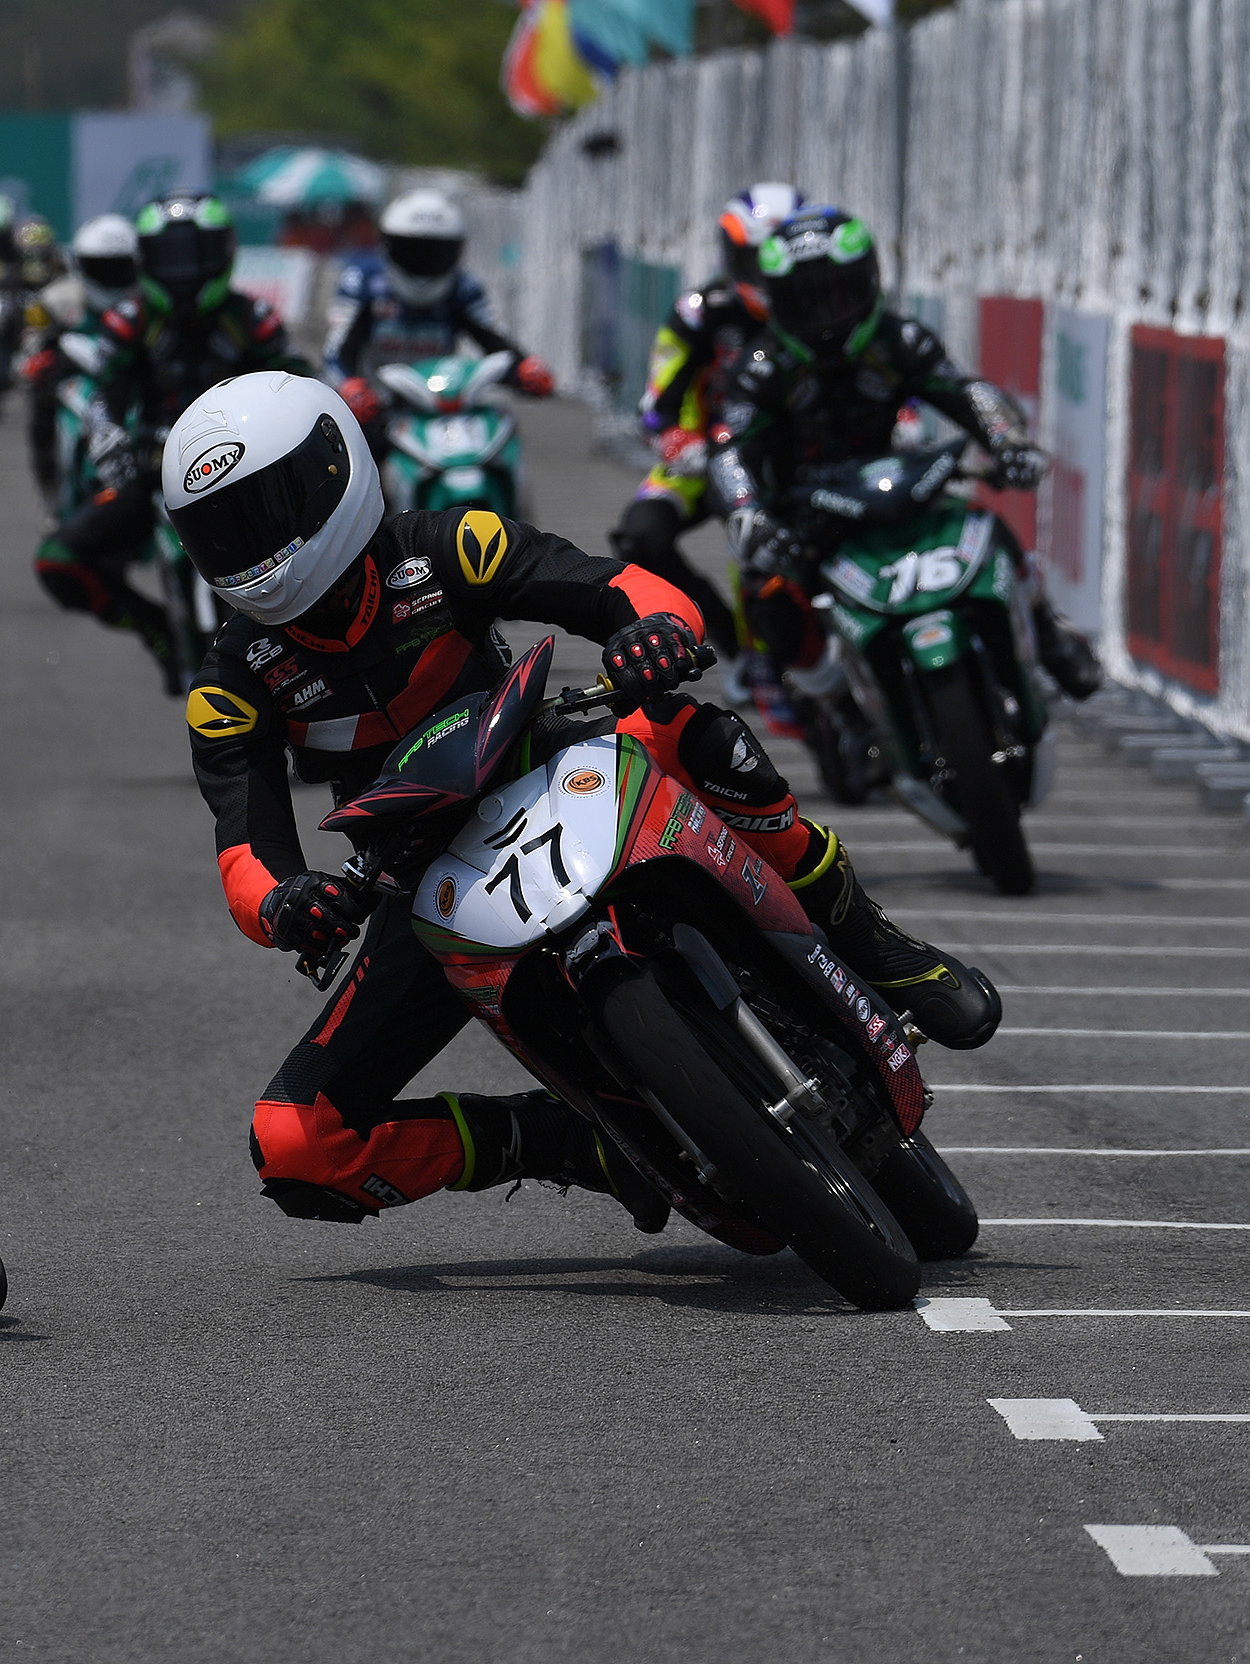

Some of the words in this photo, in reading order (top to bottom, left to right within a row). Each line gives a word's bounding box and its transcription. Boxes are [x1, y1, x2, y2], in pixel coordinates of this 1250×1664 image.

[186, 450, 239, 486] SUOMY
[390, 565, 431, 582] SUOM
[360, 569, 377, 627] TAICHI
[411, 589, 443, 606] SEPANG
[294, 679, 326, 706] AHM
[576, 775, 597, 786] KBS
[704, 780, 748, 800] TAICHI
[485, 822, 571, 924] 77
[888, 1044, 909, 1070] NGK
